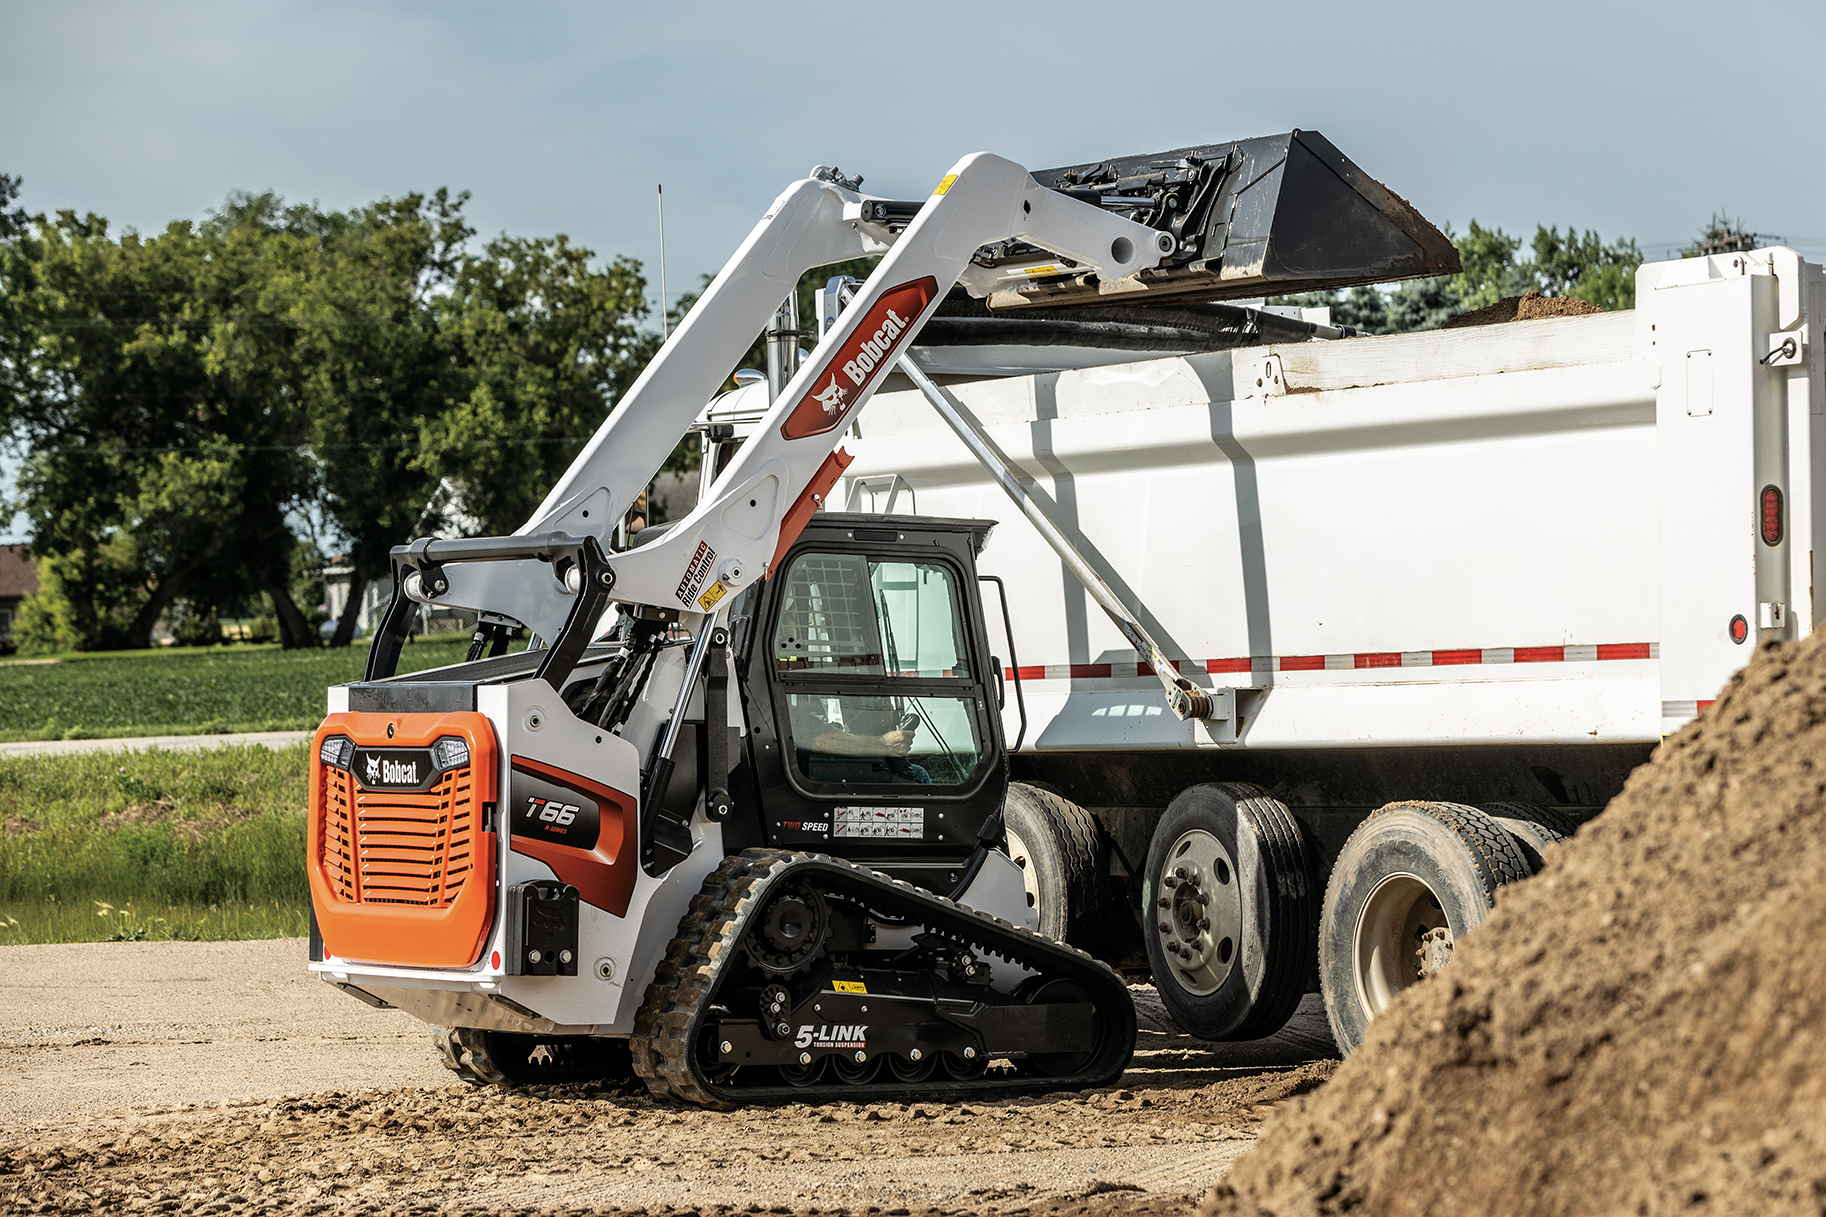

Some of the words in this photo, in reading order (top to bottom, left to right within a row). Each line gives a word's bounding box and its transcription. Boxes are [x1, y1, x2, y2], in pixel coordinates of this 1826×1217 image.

[842, 309, 906, 386] Bobcat
[678, 543, 706, 596] AUTOMATIC
[681, 583, 698, 608] Ride
[693, 546, 716, 584] Control
[525, 797, 581, 826] T66
[544, 825, 568, 835] R-SERIES
[782, 821, 801, 830] TWO
[801, 822, 829, 832] SPEED
[794, 1024, 869, 1049] 5-LINK
